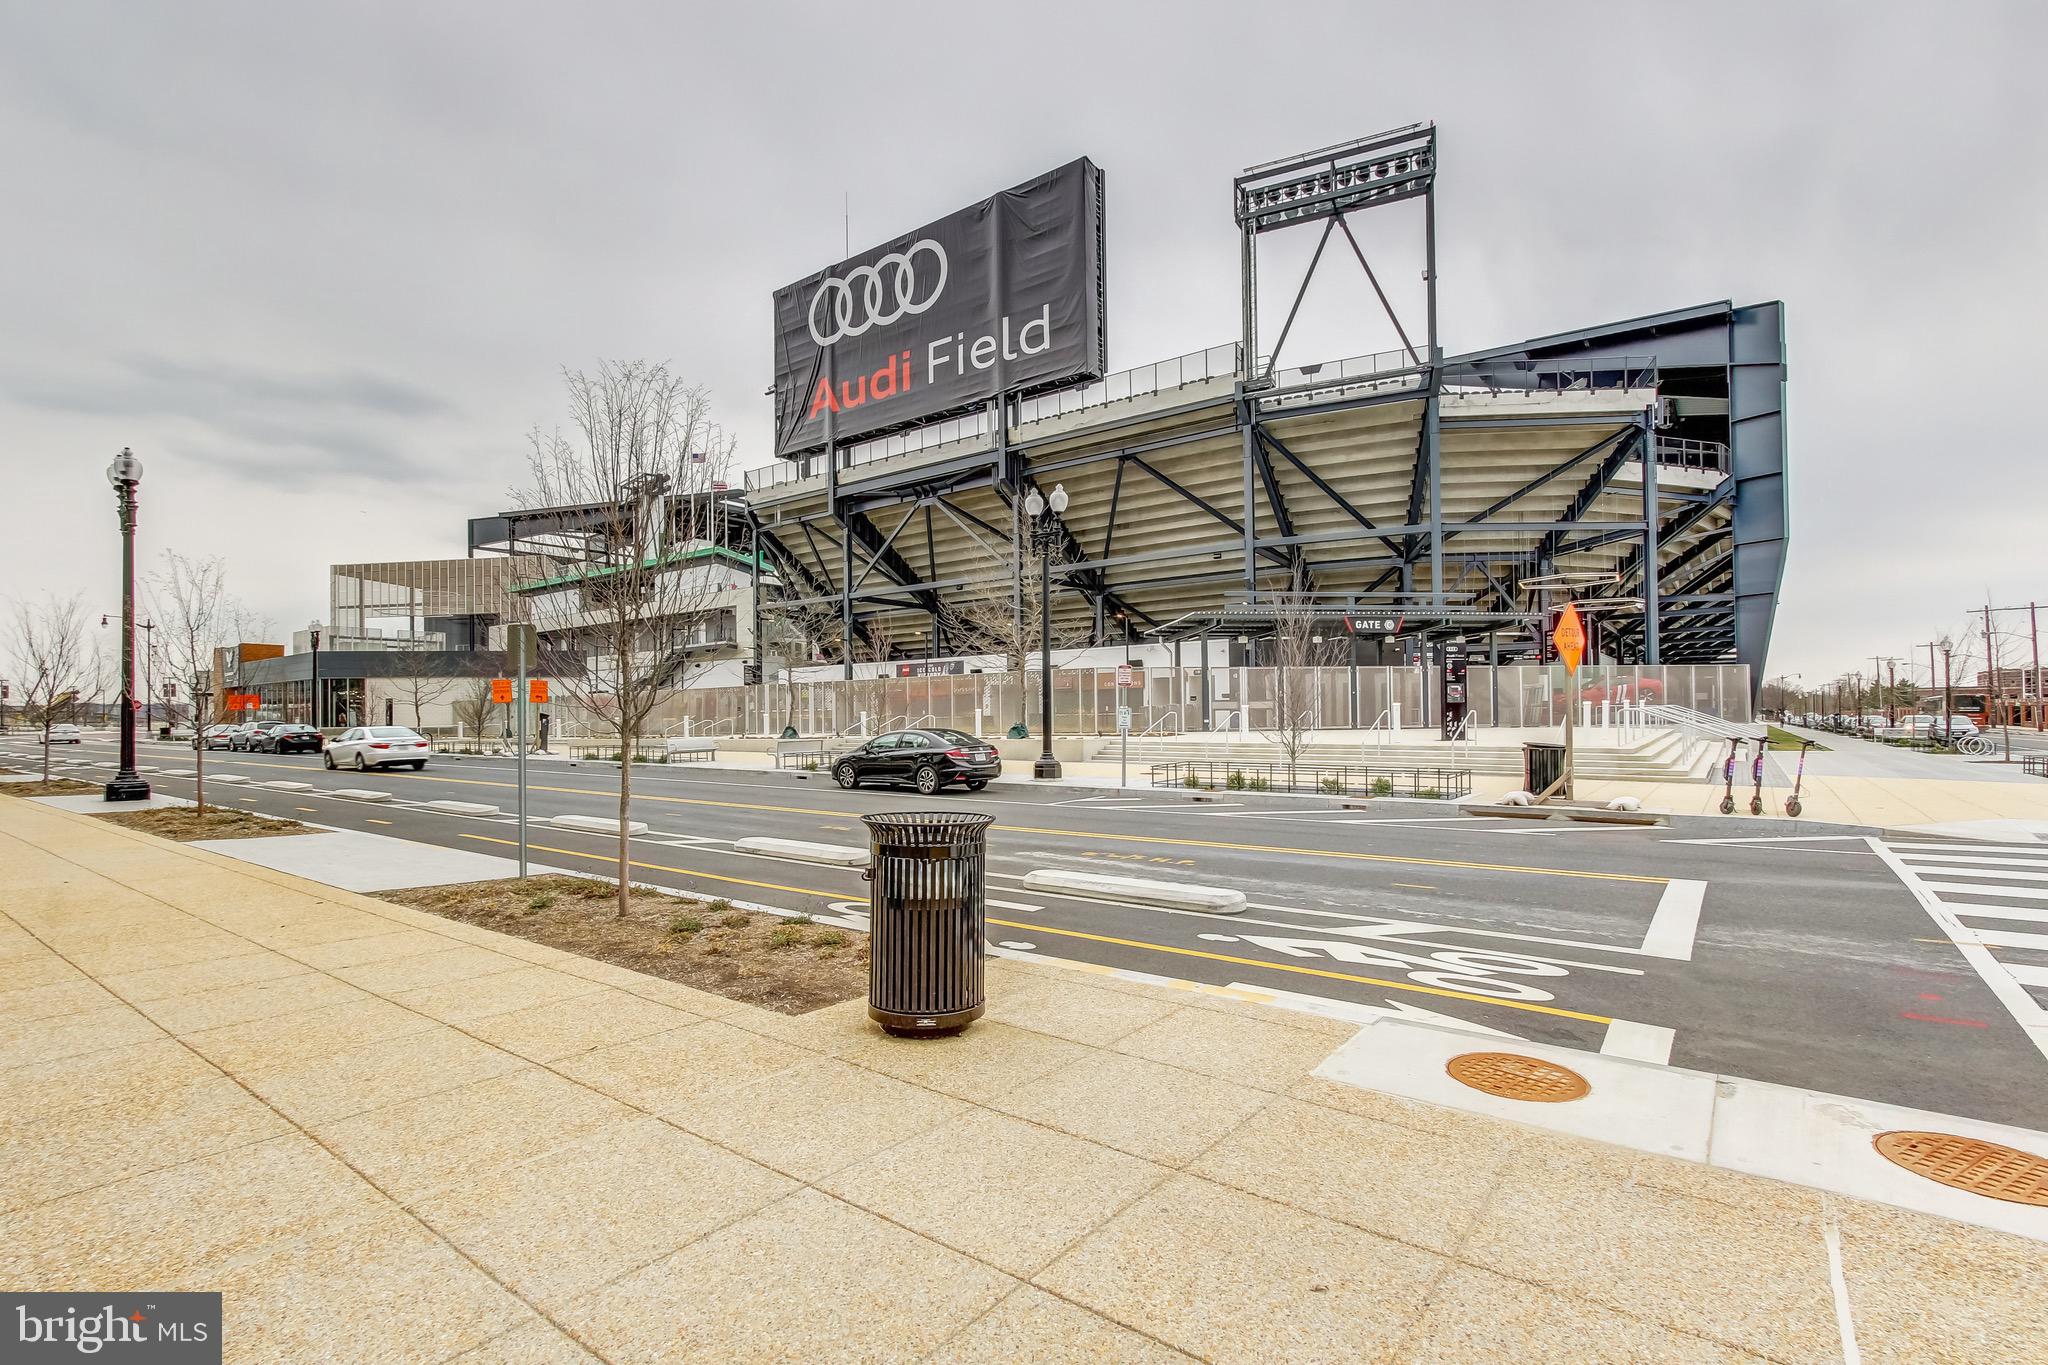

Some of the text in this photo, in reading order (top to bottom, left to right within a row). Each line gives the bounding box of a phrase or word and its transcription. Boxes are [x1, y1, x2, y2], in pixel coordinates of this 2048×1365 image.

[809, 304, 1051, 420] Audi Field
[1355, 620, 1381, 629] GATE
